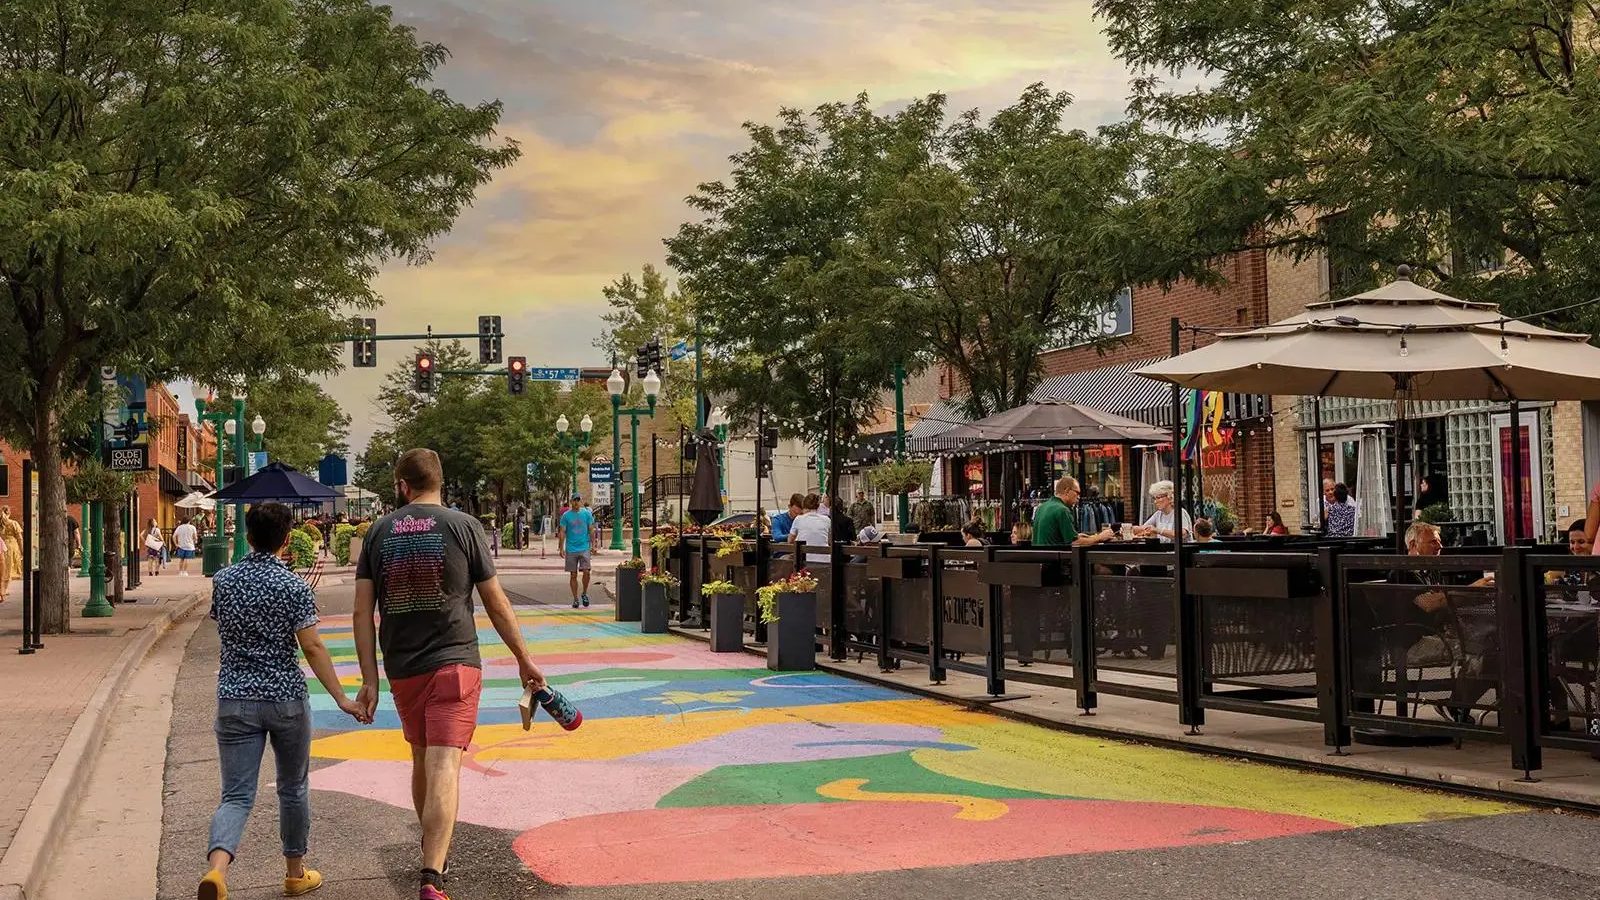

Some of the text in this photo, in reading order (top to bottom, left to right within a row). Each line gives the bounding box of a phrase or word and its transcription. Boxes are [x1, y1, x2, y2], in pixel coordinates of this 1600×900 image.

[549, 370, 559, 379] 57
[115, 450, 139, 459] OLDE
[1202, 449, 1236, 468] LOTHE
[115, 458, 141, 466] TOWN
